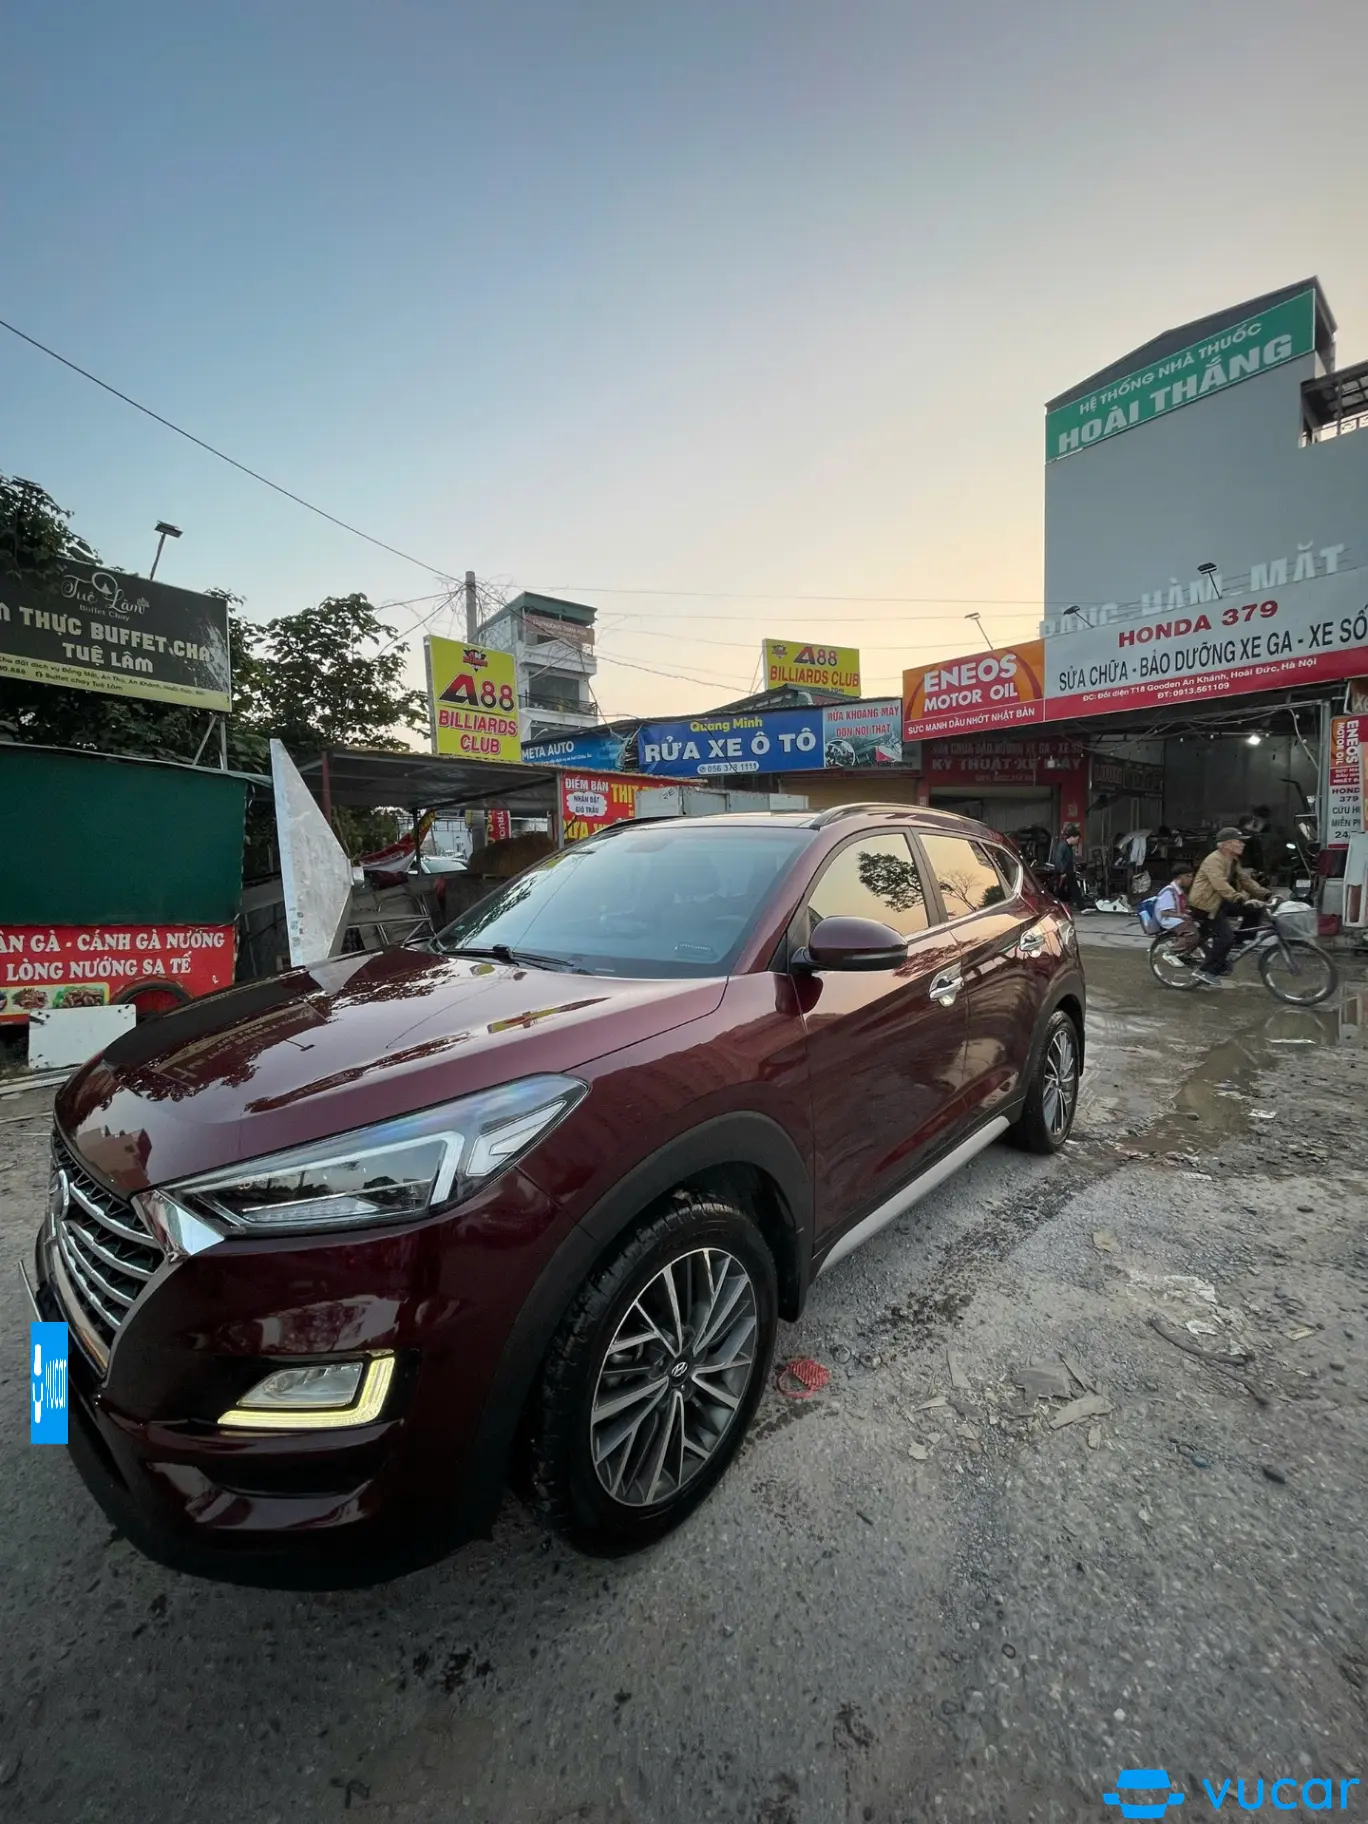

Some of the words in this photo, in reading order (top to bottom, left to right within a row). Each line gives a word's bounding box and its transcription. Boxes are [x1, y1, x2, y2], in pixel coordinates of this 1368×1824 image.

[1079, 396, 1097, 415] HỆ
[1100, 371, 1155, 405] THỐNG
[1158, 351, 1195, 379] NHÀ
[1198, 321, 1263, 359] THUỐC
[1058, 400, 1139, 453] HOÀI
[1150, 334, 1292, 413] THẮNG
[19, 606, 82, 636] THỰC
[90, 622, 167, 653] BUFFET
[173, 640, 211, 661] CHA
[1118, 614, 1212, 648] HONDA
[1222, 600, 1278, 626] 379
[62, 642, 104, 666] TUỆ
[111, 650, 154, 673] LÂM
[793, 646, 838, 667] A88
[1059, 665, 1086, 691] SỬA
[1090, 659, 1128, 686] CHỮA
[1140, 649, 1170, 677] BẢO
[1175, 641, 1236, 672] DƯỠNG
[1240, 636, 1261, 660] XE
[1267, 630, 1292, 656] GA
[1309, 622, 1333, 648] XE
[1340, 603, 1368, 643] SỐ
[770, 665, 829, 685] BILLIARDS
[831, 671, 860, 688] CLUB
[924, 654, 1017, 693] ENEOS
[1147, 680, 1180, 692] Gooden
[1183, 677, 1194, 686] An
[1196, 672, 1229, 684] Khánh,
[1231, 669, 1253, 679] Hoài
[1255, 665, 1280, 675] Đức,
[1281, 661, 1296, 670] Hà
[1298, 657, 1317, 668] Nội
[439, 673, 515, 712] A88
[924, 689, 982, 712] MOTOR
[990, 682, 1018, 700] OIL
[438, 709, 518, 737] BILLIARDS
[690, 718, 730, 733] Quang
[733, 715, 763, 730] Minh
[846, 708, 879, 720] KHOANG
[908, 725, 924, 735] SỨC
[949, 716, 966, 729] DẦU
[966, 713, 990, 726] NHỚT
[991, 710, 1014, 722] NHẬT
[1016, 706, 1035, 718] BẢN
[460, 734, 501, 754] CLUB
[521, 746, 546, 760] META
[548, 740, 575, 756] AUTO
[644, 735, 700, 763] RỬA
[708, 736, 742, 758] XE
[751, 731, 771, 755] Ô
[779, 727, 816, 753] TÔ
[1336, 722, 1346, 750] MOTOR
[1346, 720, 1360, 764] ENEOS
[565, 776, 589, 790] ĐIỂM
[590, 779, 609, 791] BÁN
[1332, 787, 1360, 795] HOND
[1334, 830, 1350, 839] 24
[30, 929, 61, 952] GÀ
[77, 928, 131, 951] CÁNH
[135, 928, 161, 950] GÀ
[166, 930, 225, 949] NƯỚNG
[6, 956, 64, 982] LÒNG
[70, 956, 137, 979] NƯỚNG
[142, 957, 164, 976] SA
[170, 951, 193, 975] TẾ
